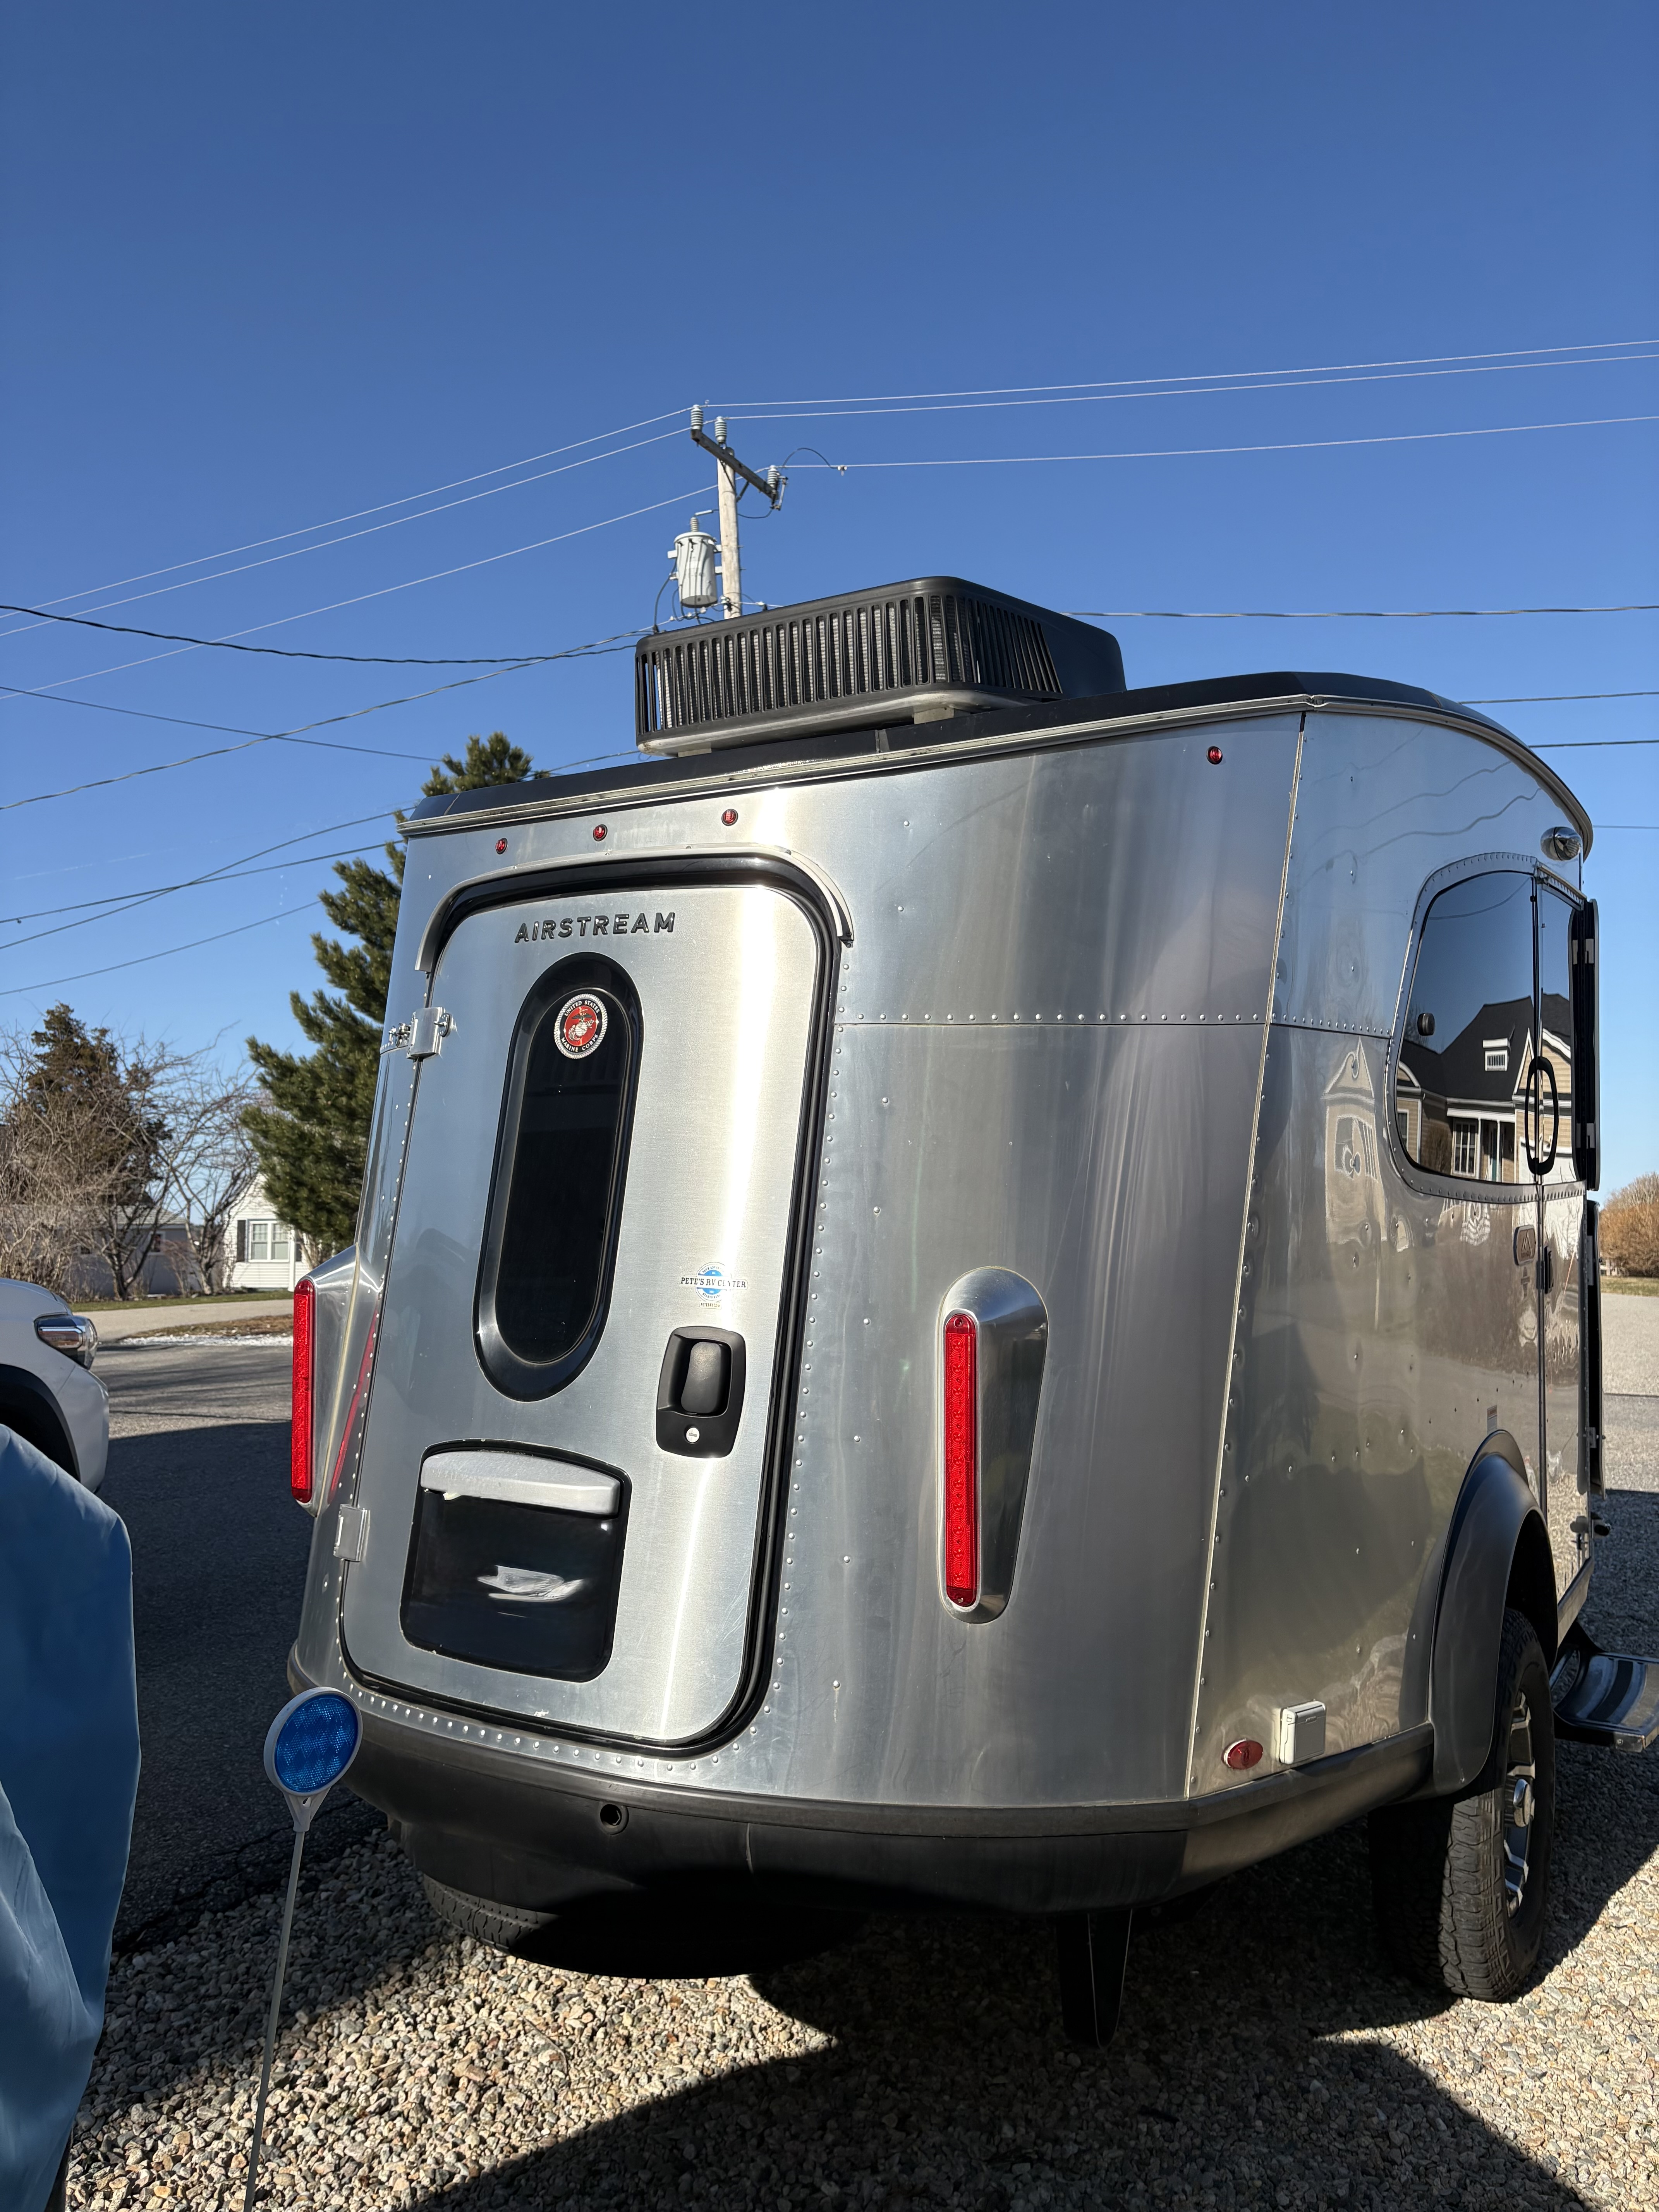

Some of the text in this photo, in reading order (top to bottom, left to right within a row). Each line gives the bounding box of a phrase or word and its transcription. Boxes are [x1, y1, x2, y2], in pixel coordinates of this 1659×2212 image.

[514, 912, 675, 943] AIRSTREAM
[564, 1000, 600, 1016] UNITED STATES
[561, 1034, 598, 1052] MARINE CORPS
